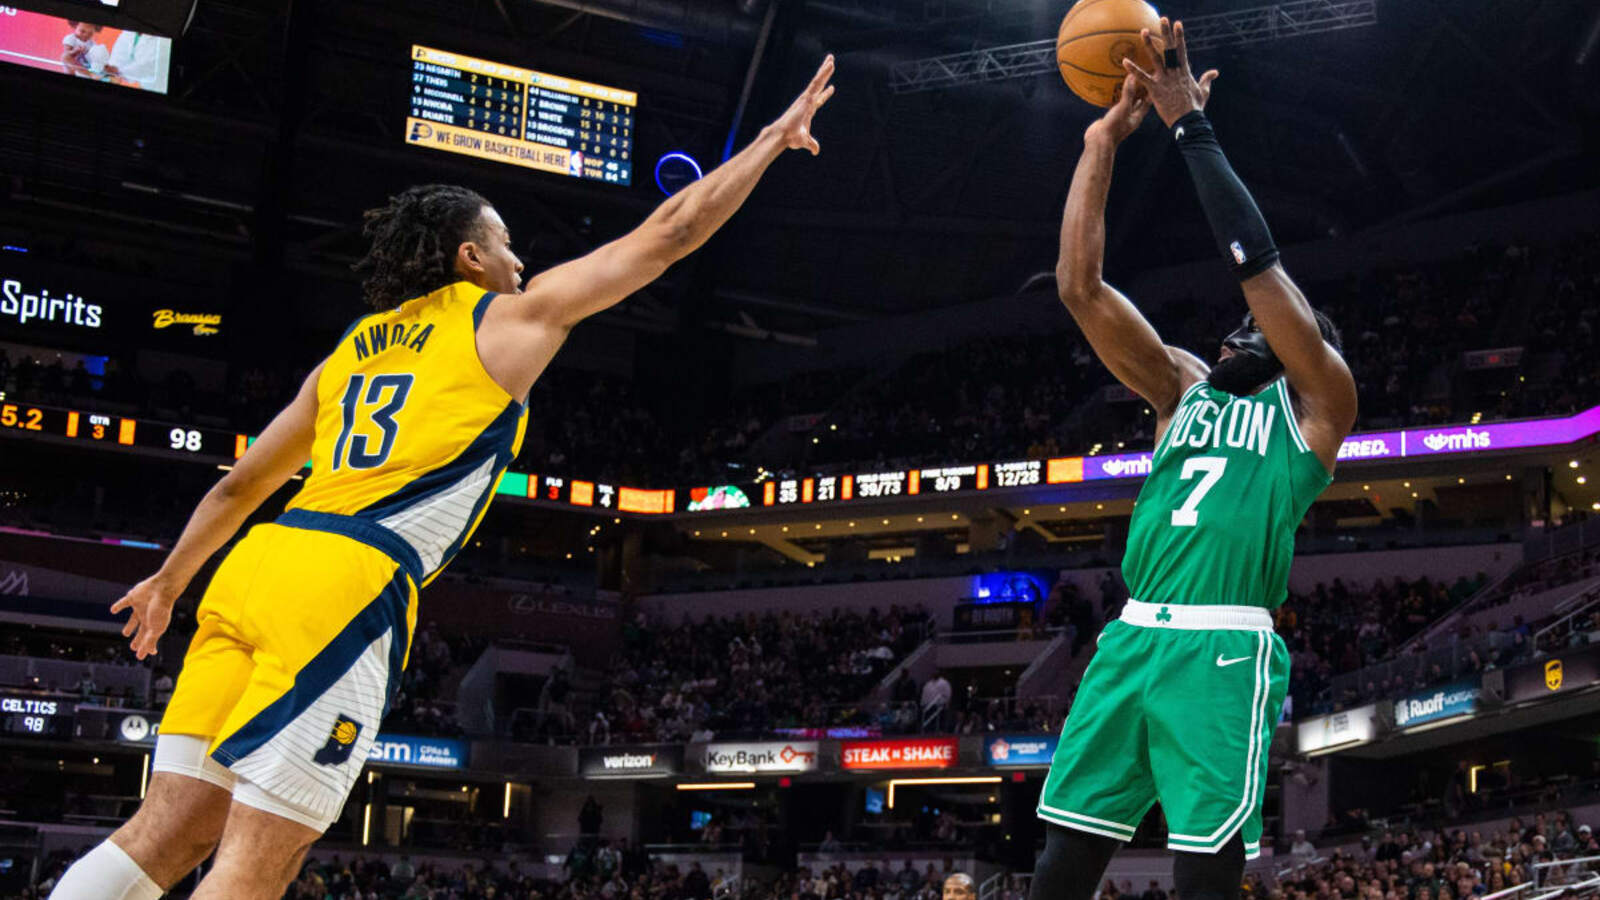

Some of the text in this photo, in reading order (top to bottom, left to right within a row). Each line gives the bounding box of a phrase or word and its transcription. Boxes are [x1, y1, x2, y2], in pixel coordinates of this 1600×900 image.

[436, 131, 566, 168] WE GROW BASKETBALL HERE
[0, 279, 102, 328] Spirits
[1, 404, 43, 431] 5.2
[332, 373, 414, 472] 13
[92, 425, 105, 439] 3
[1171, 399, 1276, 457] OSTON
[169, 428, 202, 451] 98
[1450, 429, 1490, 449] mhs
[1338, 439, 1390, 459] ERED.
[1124, 455, 1152, 475] mh
[934, 476, 960, 491] 8/9
[997, 470, 1039, 486] 12/28
[779, 488, 797, 503] 35
[818, 485, 835, 500] 21
[859, 481, 901, 497] 39/73
[1171, 456, 1228, 526] 7
[600, 494, 611, 508] 4
[2, 699, 57, 715] CELTICS
[1410, 691, 1445, 718] Ruoff
[24, 717, 44, 732] 98
[369, 741, 411, 761] sm
[708, 749, 776, 768] KeyBank
[843, 747, 890, 763] STEAK
[902, 746, 952, 761] SHAKE
[604, 754, 652, 769] verizon
